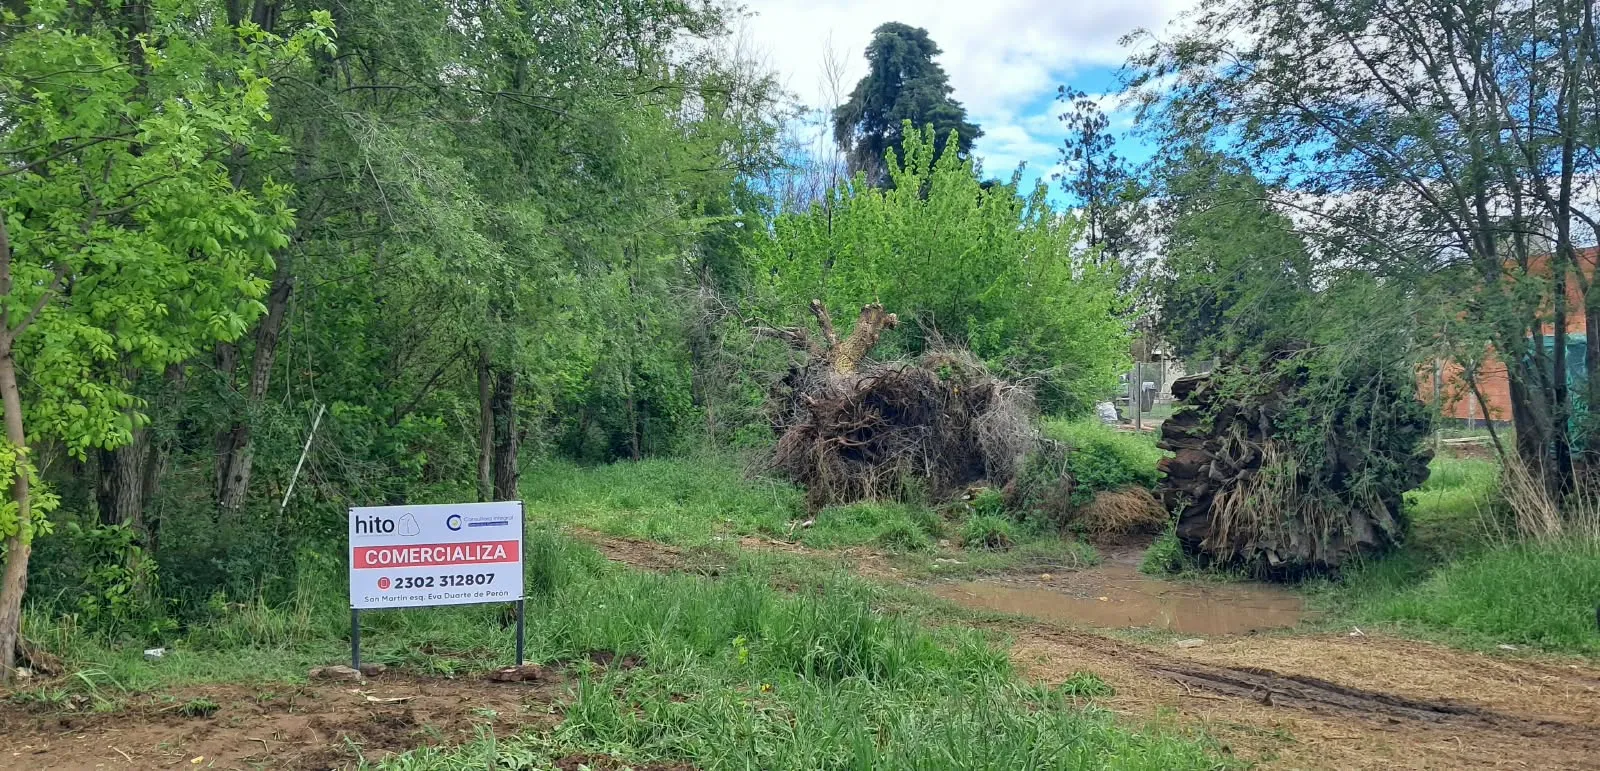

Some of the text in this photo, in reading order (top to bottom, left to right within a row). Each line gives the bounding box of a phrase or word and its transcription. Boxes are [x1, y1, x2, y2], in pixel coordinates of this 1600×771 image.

[356, 515, 395, 534] hito
[365, 544, 507, 565] COMERCIALIZA
[394, 573, 495, 589] 2302 312807
[409, 594, 426, 602] esq.
[444, 591, 471, 599] Duarte
[485, 590, 508, 598] Perón
